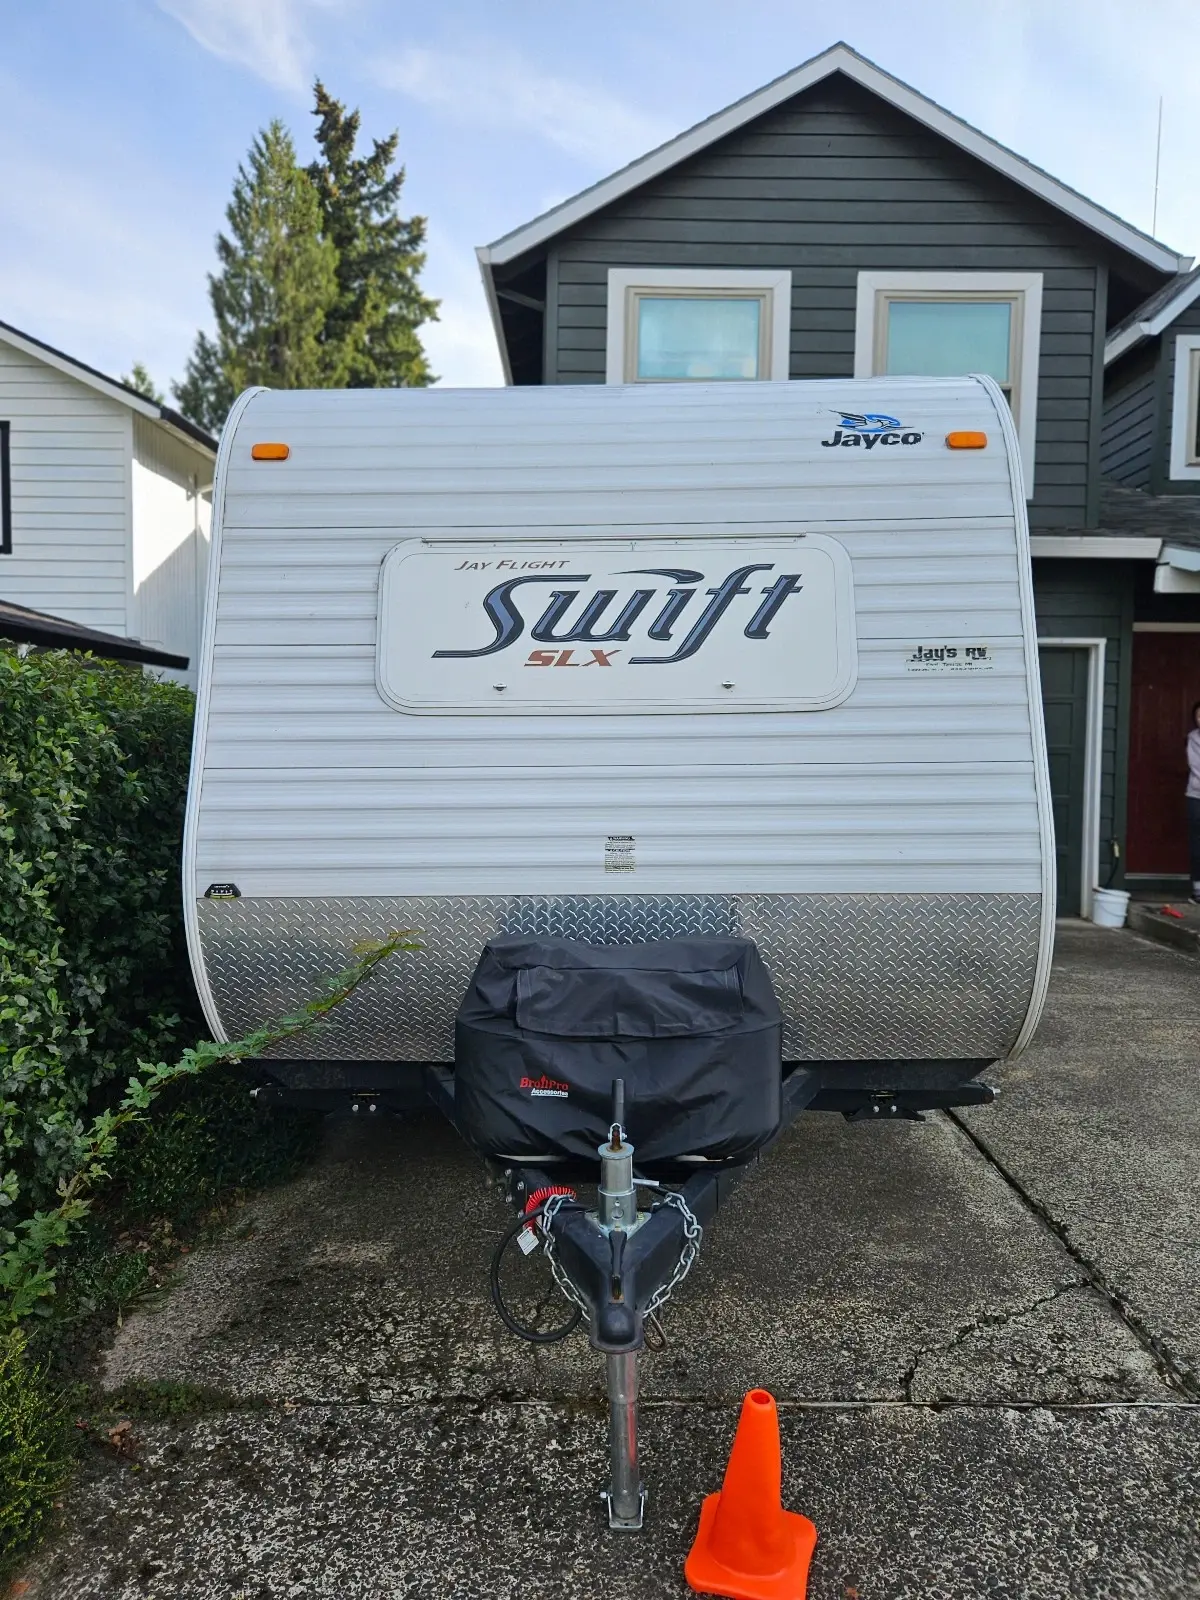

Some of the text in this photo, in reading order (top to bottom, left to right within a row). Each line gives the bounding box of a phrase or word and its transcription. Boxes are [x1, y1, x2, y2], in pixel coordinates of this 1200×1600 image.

[821, 430, 922, 449] Jayco
[431, 563, 803, 664] Swift
[524, 649, 622, 667] SLX
[912, 645, 988, 661] Jay's RV
